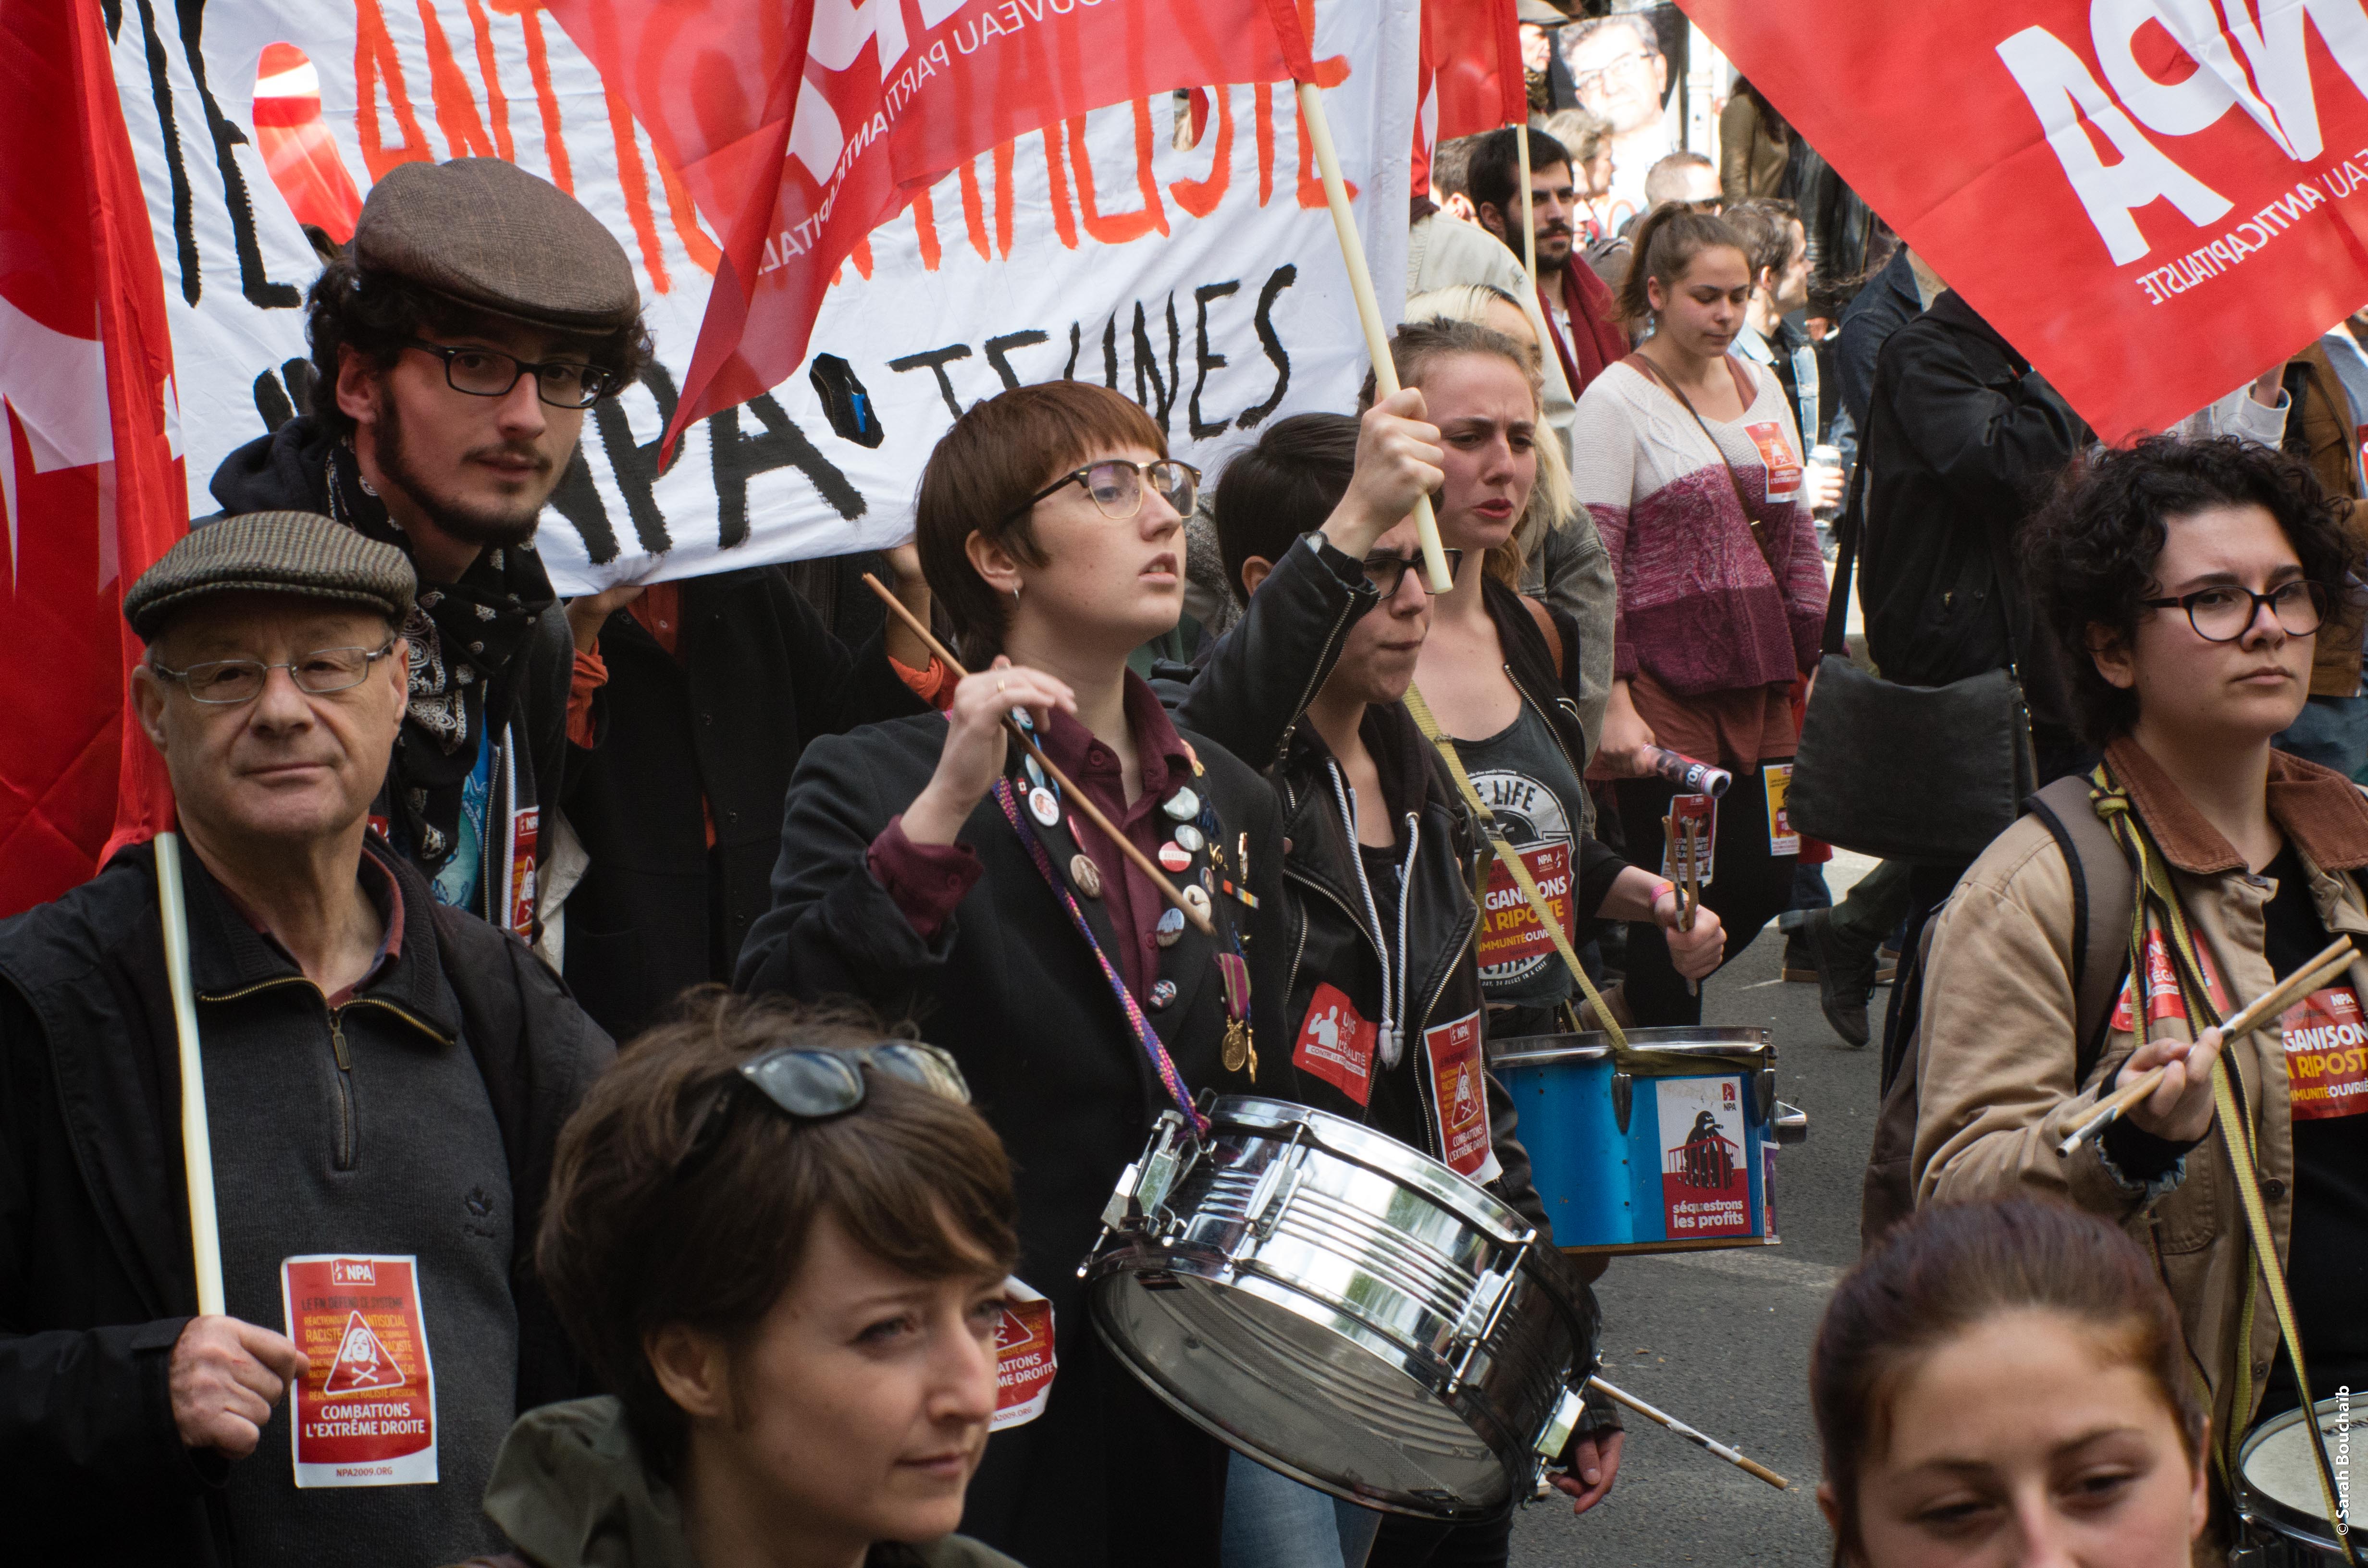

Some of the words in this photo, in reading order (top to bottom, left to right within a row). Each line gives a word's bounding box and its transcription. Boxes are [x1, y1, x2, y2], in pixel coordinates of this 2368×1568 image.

[1493, 780, 1536, 812] LIFE
[1537, 853, 1553, 866] NPA
[1485, 876, 1567, 910] GANONS
[1496, 898, 1565, 931] RIPOTE
[2330, 993, 2355, 1006] NPA
[1457, 1024, 1469, 1039] NPA
[1723, 1102, 1737, 1112] NPA
[1452, 1124, 1483, 1148] COMBATTONS
[1673, 1200, 1743, 1215] séquestrons
[1674, 1214, 1695, 1228] les
[1699, 1211, 1744, 1229] profits
[346, 1264, 373, 1281] NPA
[306, 1327, 343, 1342] RACISTE
[1016, 1362, 1054, 1384] DROITE
[321, 1403, 411, 1421] COMBATTONS
[306, 1419, 378, 1438] L'EXTRÊME
[381, 1419, 426, 1435] DROITE
[336, 1466, 393, 1477] NPA2009.ORG
